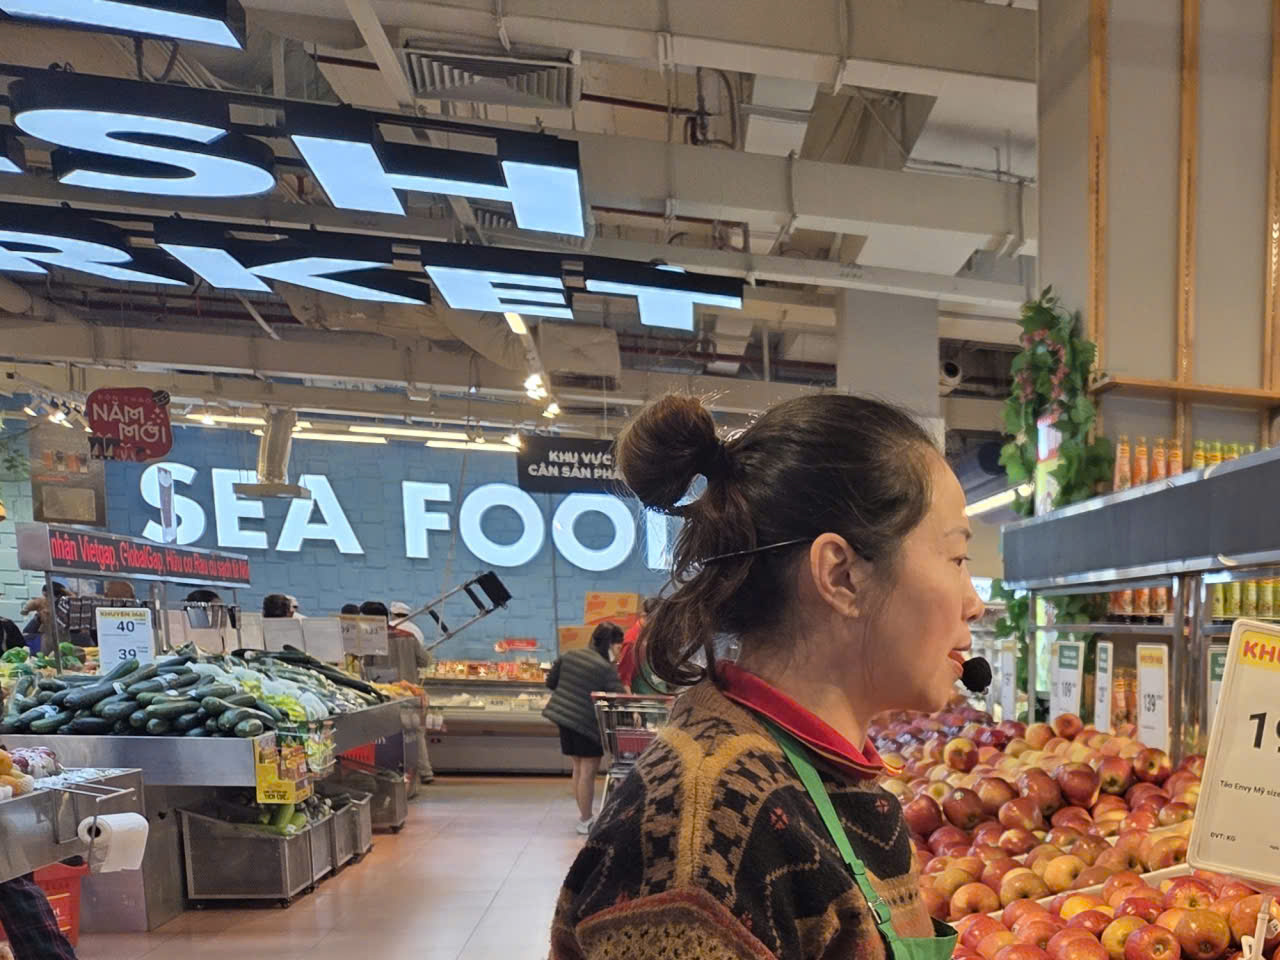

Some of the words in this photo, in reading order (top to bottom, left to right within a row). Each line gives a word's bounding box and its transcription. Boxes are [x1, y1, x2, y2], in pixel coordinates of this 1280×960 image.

[0, 108, 585, 238] SH
[92, 400, 145, 424] NĂM
[118, 421, 167, 444] MỚI
[140, 461, 365, 555] SEA
[116, 620, 135, 633] 40
[118, 648, 137, 660] 39
